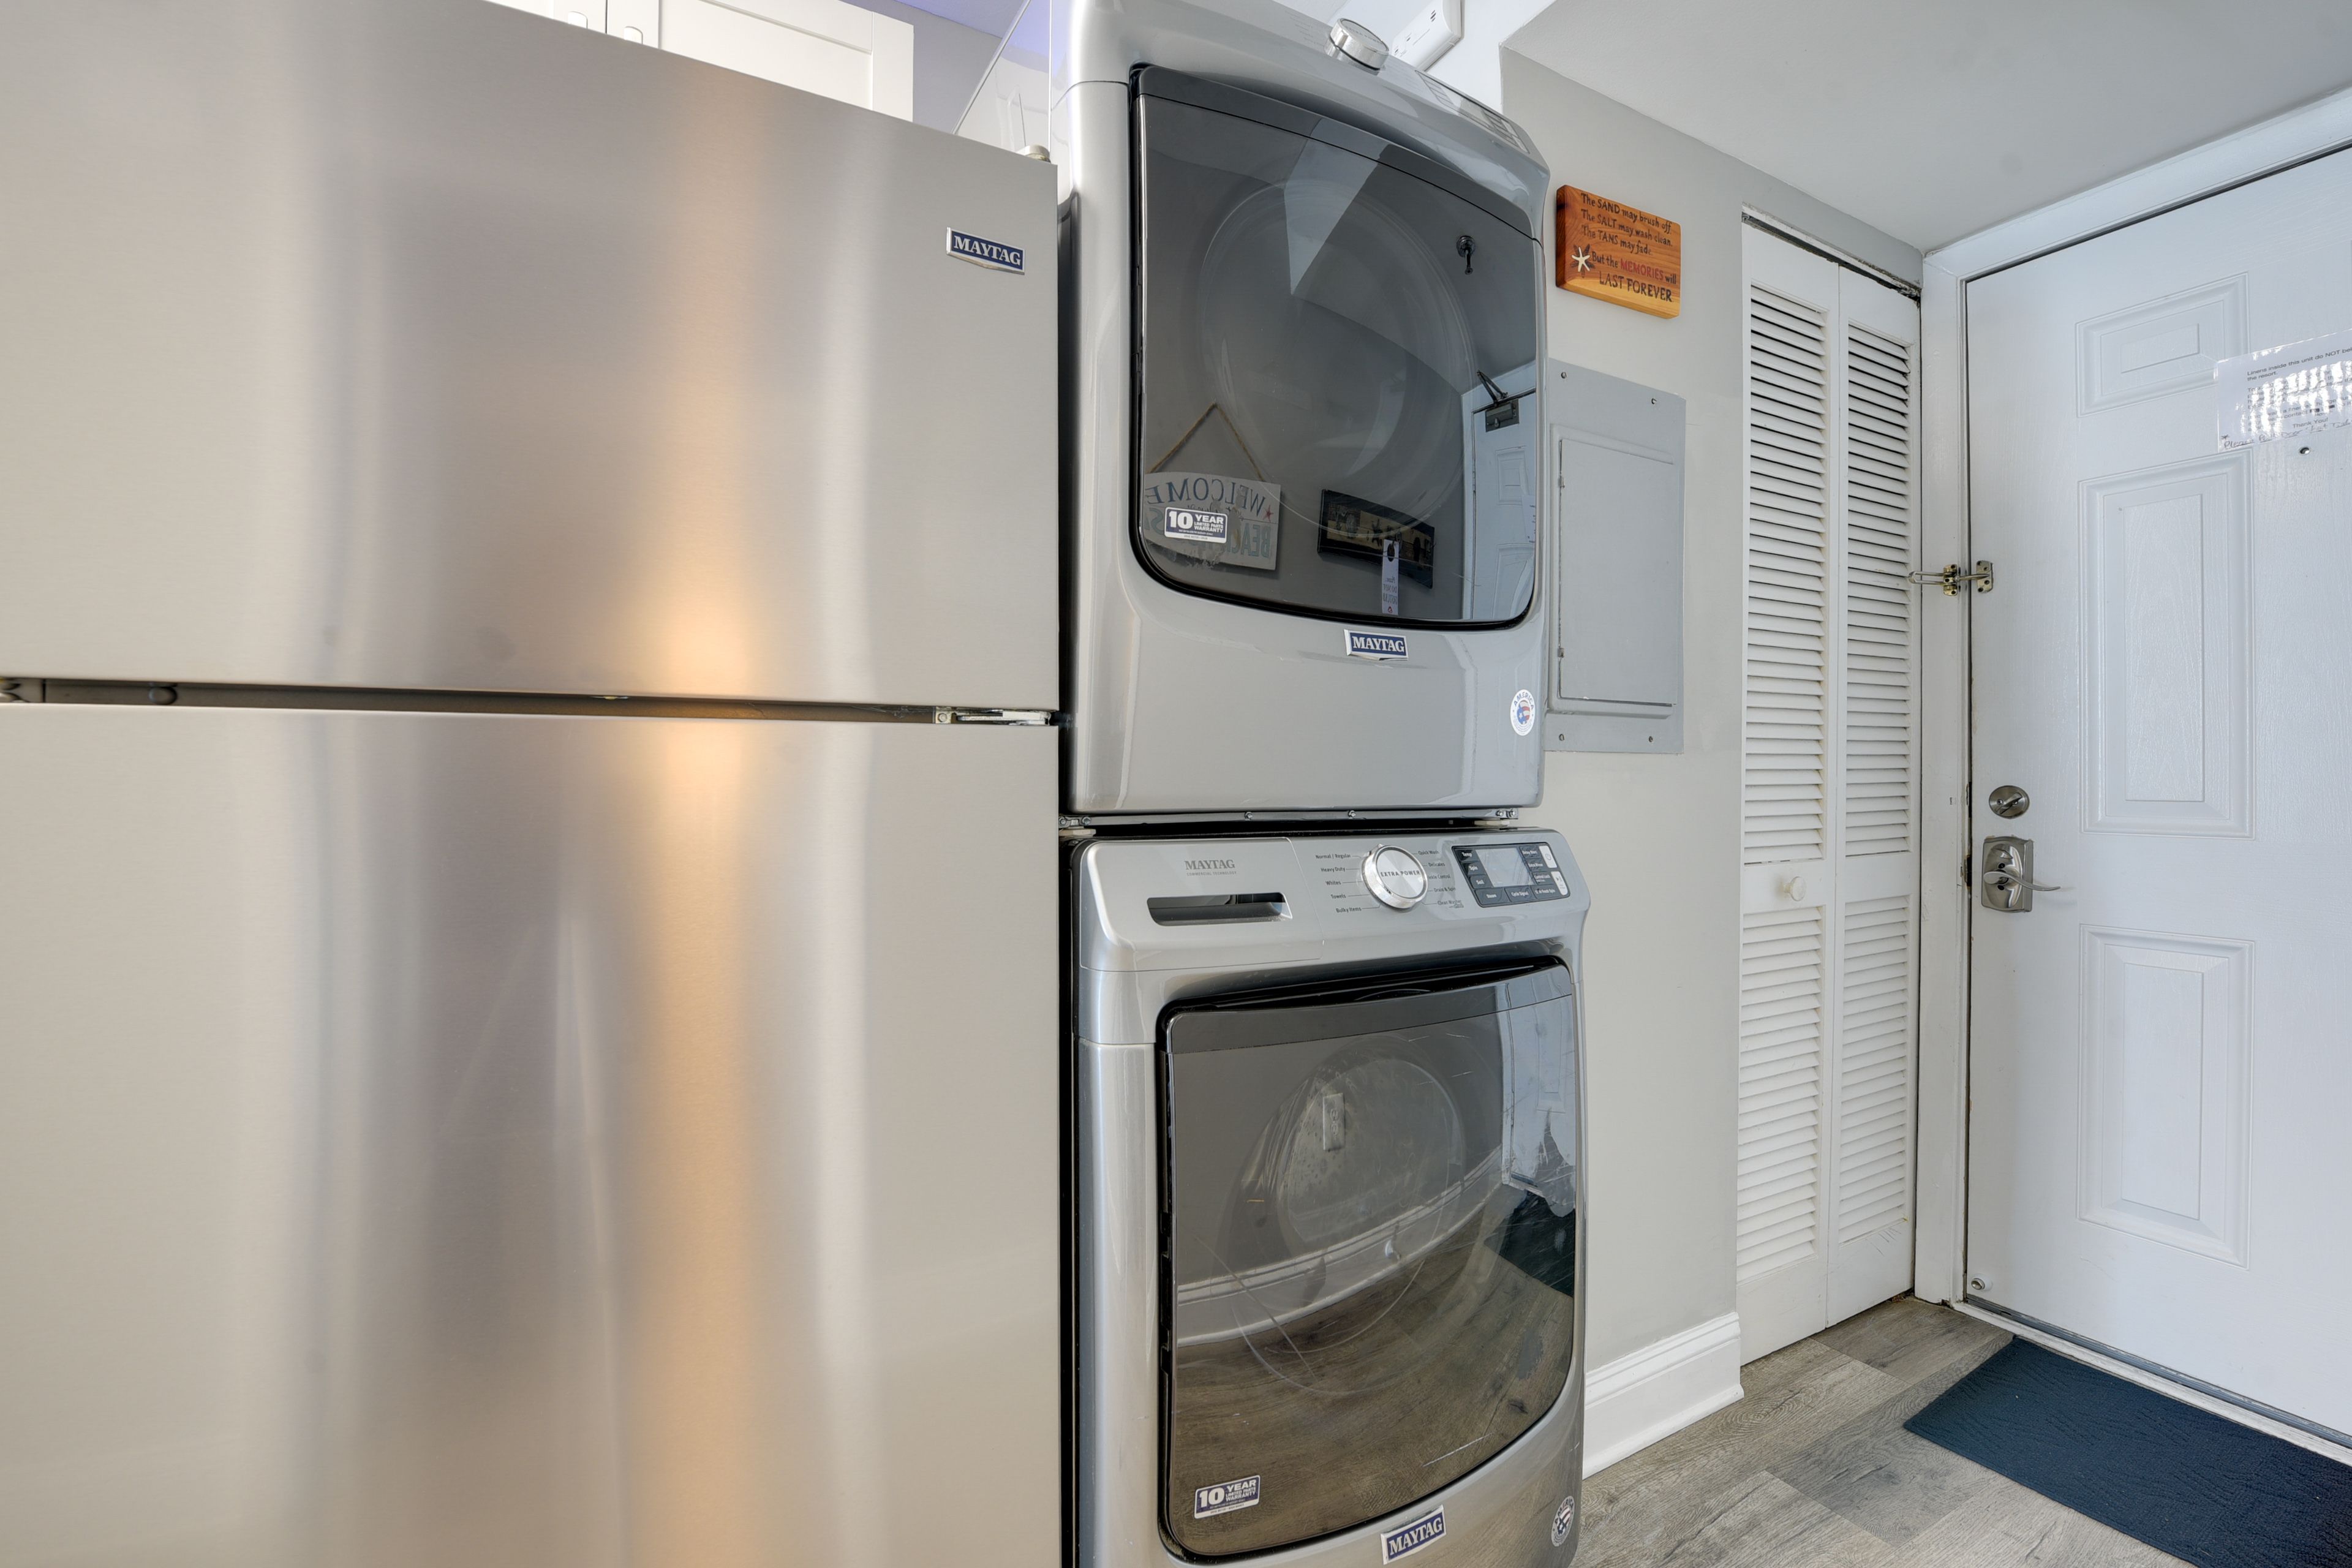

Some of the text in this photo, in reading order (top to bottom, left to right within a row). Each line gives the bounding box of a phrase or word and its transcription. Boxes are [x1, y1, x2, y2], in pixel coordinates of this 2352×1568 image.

[1581, 193, 1596, 206] The
[1597, 199, 1620, 214] SAND
[1621, 209, 1637, 223] may
[1639, 211, 1659, 227] brush
[1581, 209, 1673, 247] The SALT may wash clean.
[1581, 225, 1596, 238] The
[1598, 230, 1618, 244] TANS
[1621, 239, 1635, 254] may
[954, 235, 1021, 266] MAYTAG
[1592, 251, 1677, 285] But the MEMORIES will
[1599, 271, 1673, 302] LAST FOREVER
[1169, 511, 1193, 529] 10
[1194, 514, 1224, 524] YEAR
[1351, 636, 1404, 652] MAYTAG
[1513, 692, 1534, 710] AMERICA
[1184, 859, 1235, 870] MAYTAG
[1199, 1487, 1225, 1508] 10
[1226, 1479, 1256, 1493] YEAR
[1226, 1490, 1256, 1502] WARRANTY
[1389, 1517, 1442, 1556] MAYTAG
